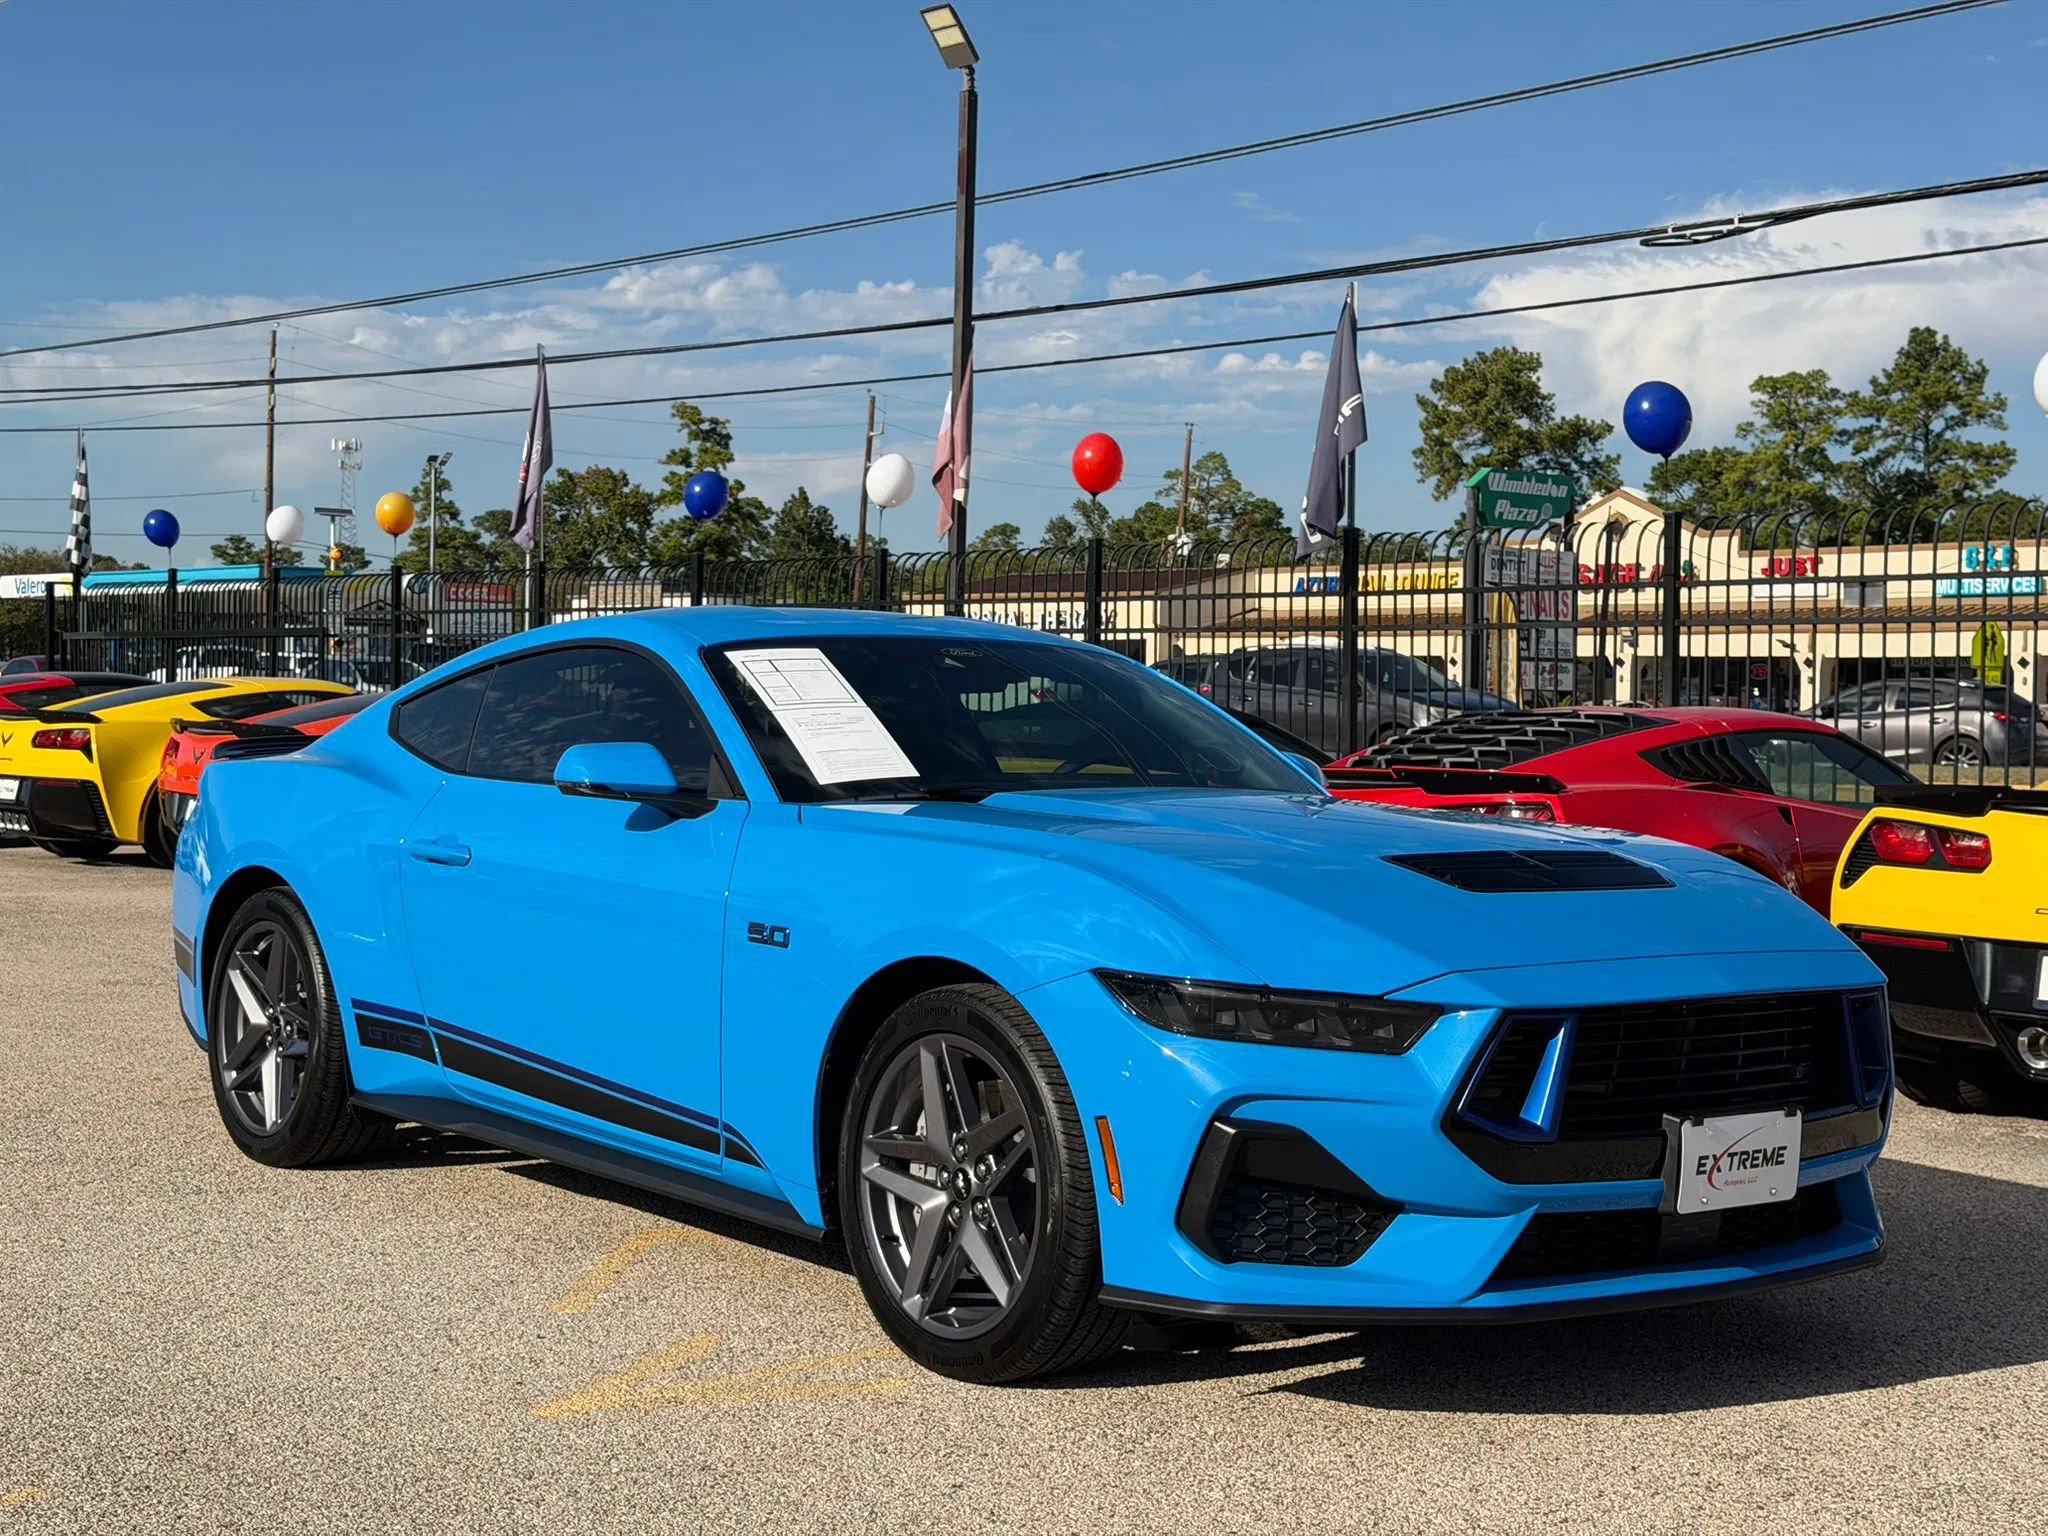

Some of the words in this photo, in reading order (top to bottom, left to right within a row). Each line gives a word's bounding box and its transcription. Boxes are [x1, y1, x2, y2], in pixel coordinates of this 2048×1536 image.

[1488, 472, 1568, 498] Wimbledon
[1495, 499, 1538, 522] Plaza
[1761, 556, 1823, 577] JUST
[15, 578, 47, 594] Valero
[1936, 577, 2042, 595] MUTISERVCES
[1529, 591, 1570, 619] NAIS
[1696, 1146, 1788, 1176] EXTREME
